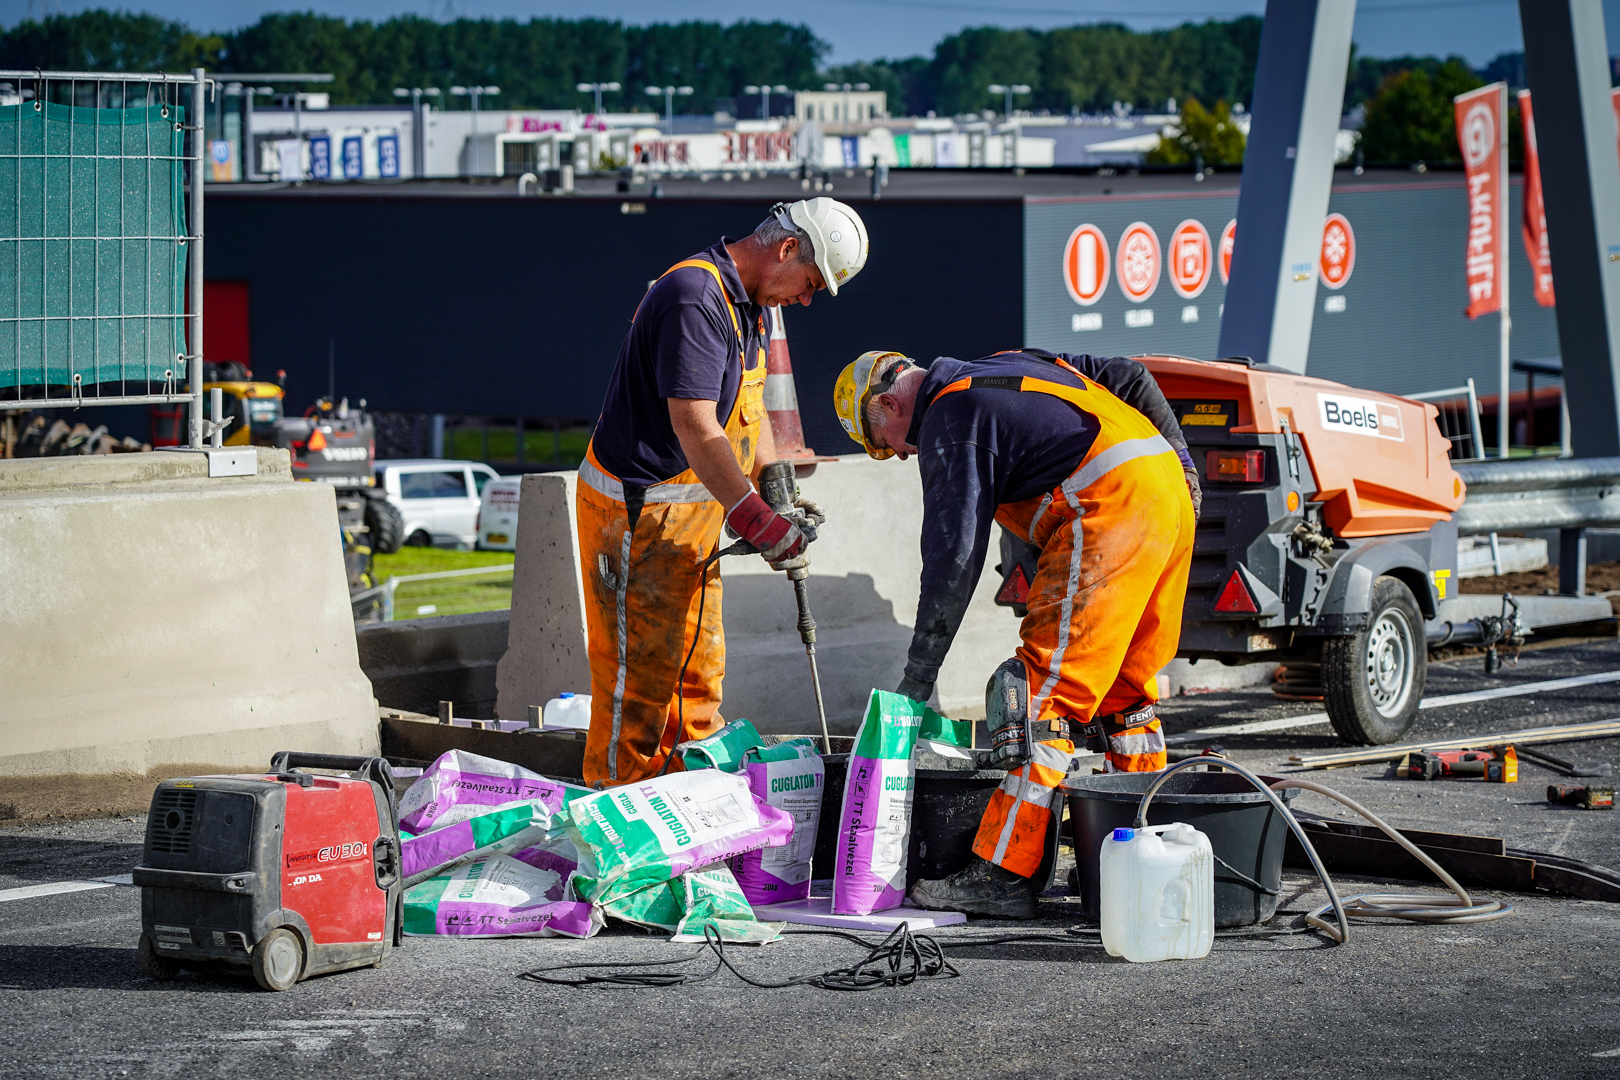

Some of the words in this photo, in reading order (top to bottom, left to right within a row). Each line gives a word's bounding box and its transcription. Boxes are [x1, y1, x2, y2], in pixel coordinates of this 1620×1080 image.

[1324, 400, 1378, 430] Boels
[451, 780, 506, 794] Staalvezel
[506, 786, 520, 795] TT
[640, 786, 653, 799] TT
[772, 774, 815, 793] CUGLATON
[617, 792, 638, 815] CUGLA
[853, 800, 864, 816] TT
[588, 803, 619, 846] CUGLATON
[648, 796, 691, 846] CUGLATON
[318, 842, 368, 862] EU30i
[845, 818, 862, 876] Staalvezel
[288, 874, 322, 886] ONDA
[480, 916, 496, 925] TT
[497, 912, 554, 925] Staalvezel
